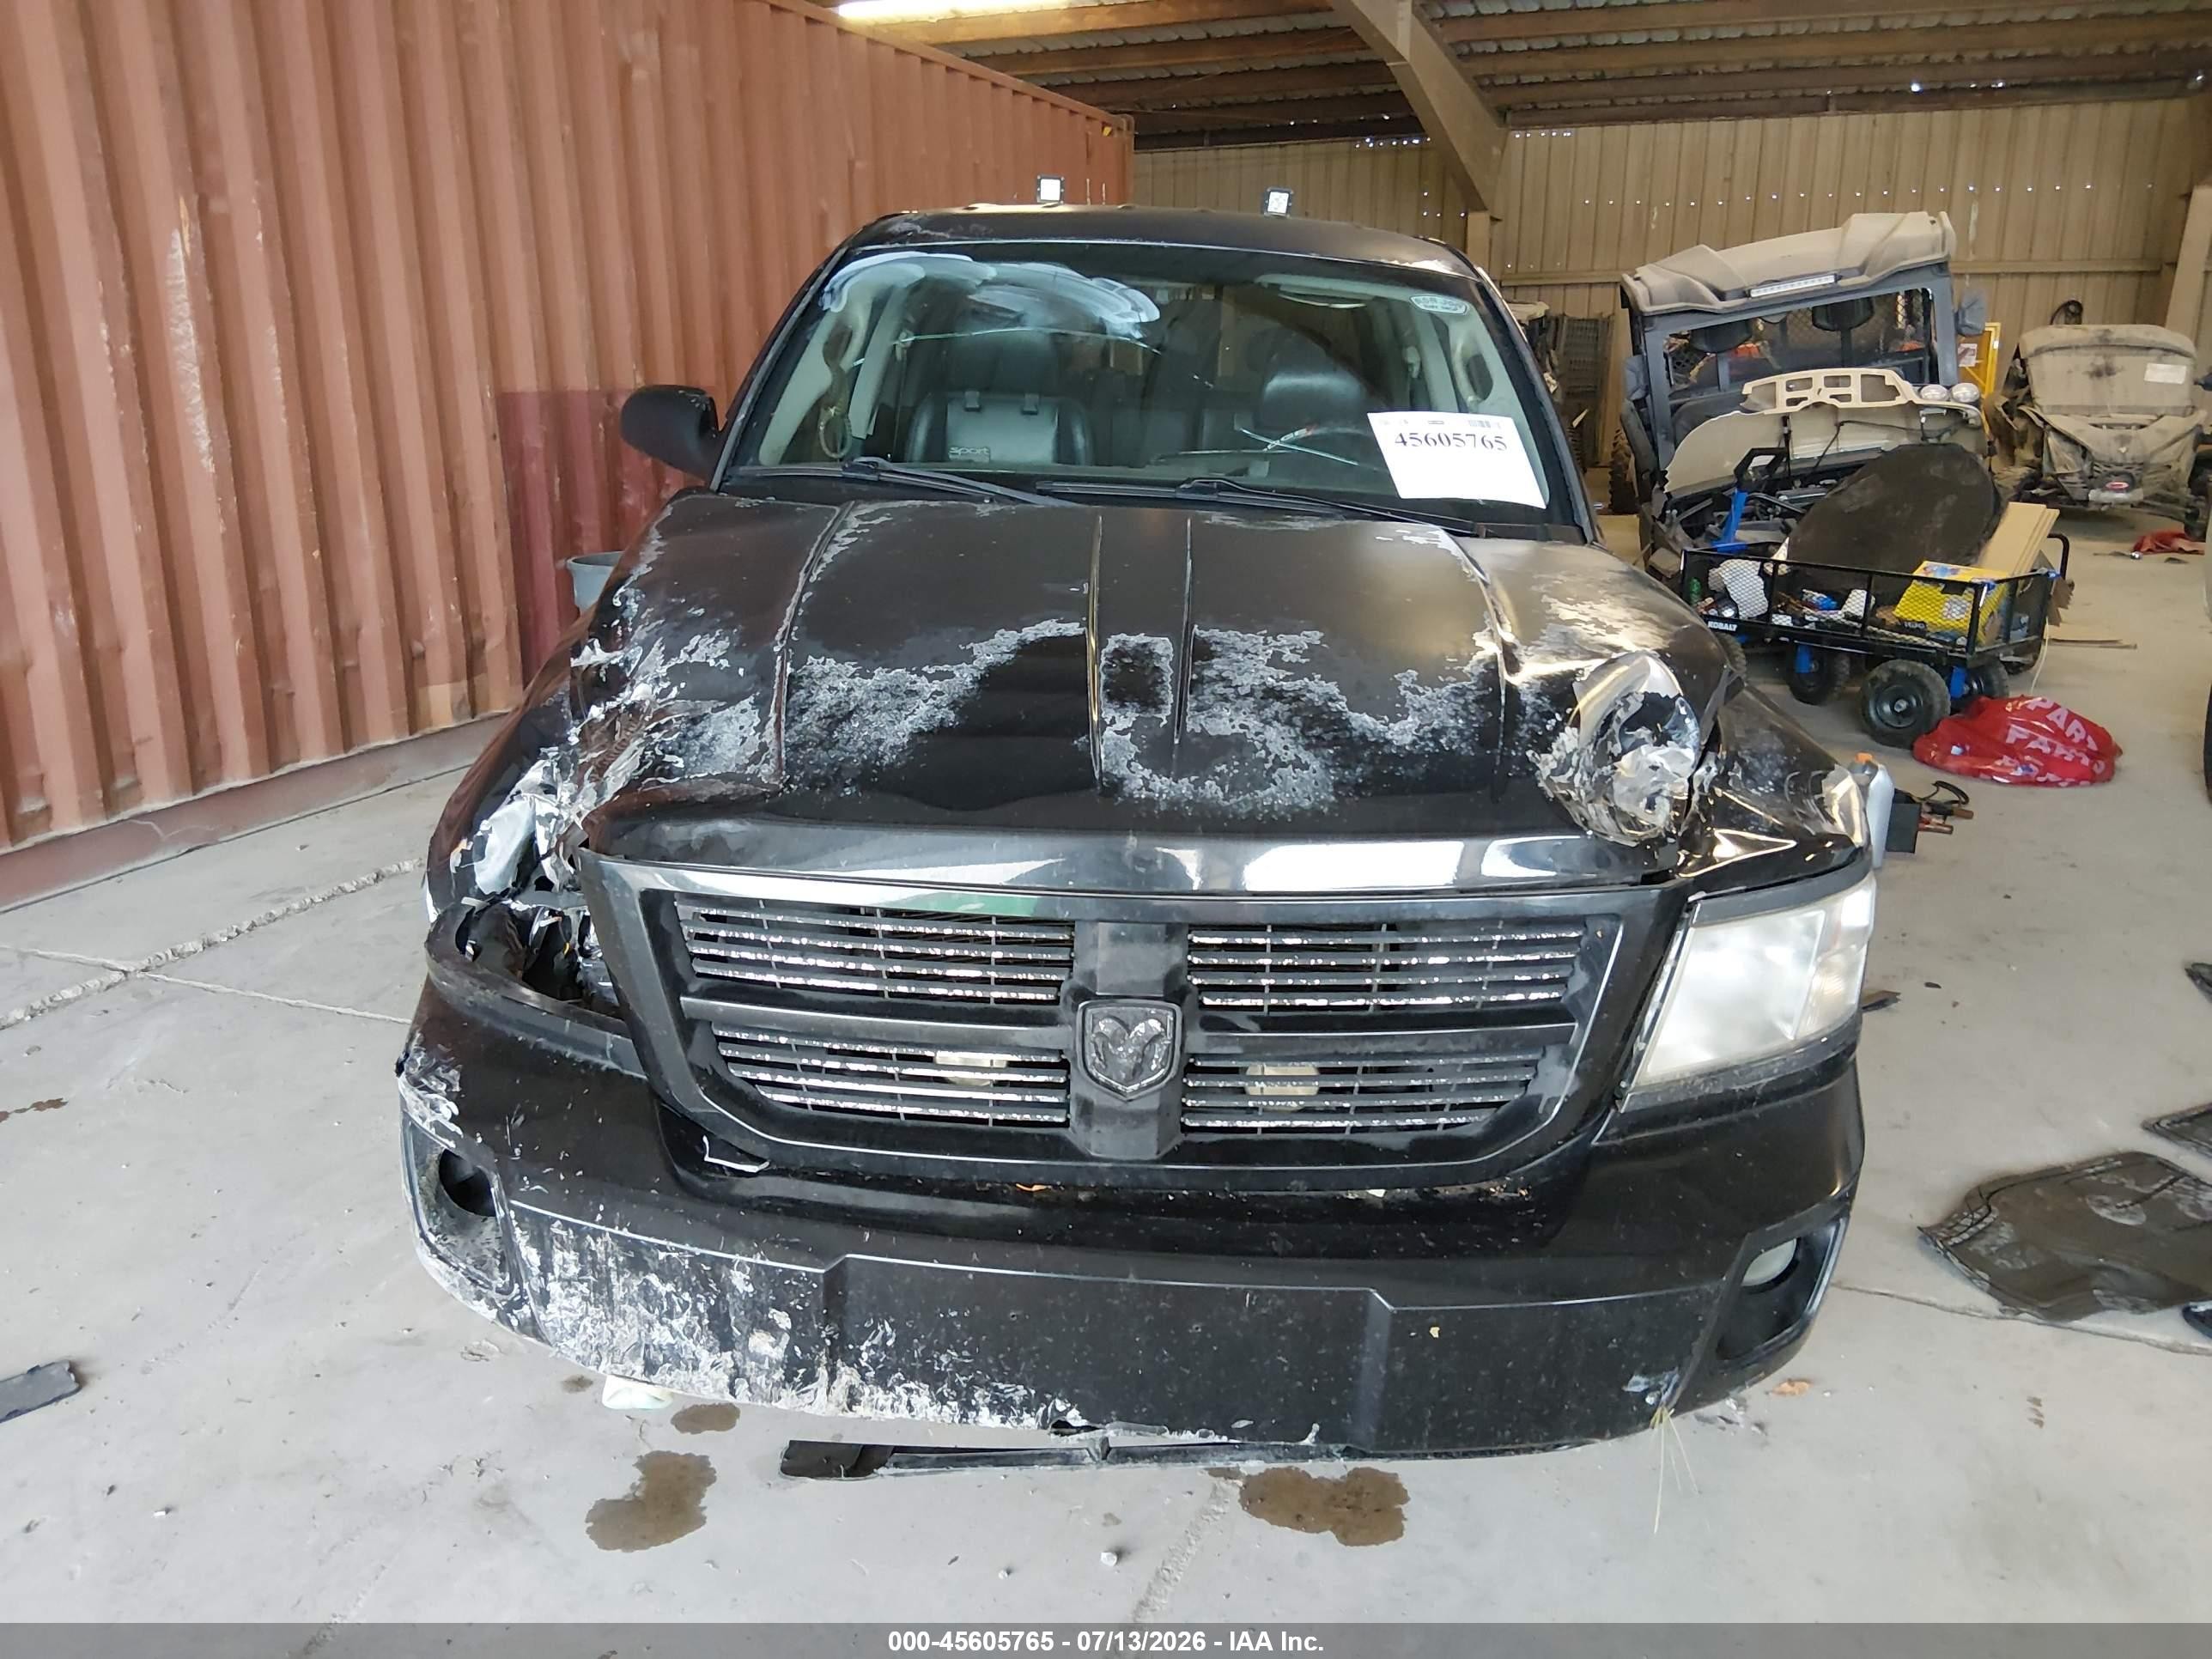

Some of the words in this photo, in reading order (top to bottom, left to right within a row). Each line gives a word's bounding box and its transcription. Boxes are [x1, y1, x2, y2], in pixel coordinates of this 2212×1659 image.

[1395, 432, 1508, 452] 45605765
[949, 447, 989, 456] sport
[1707, 620, 1738, 632] KOBALT
